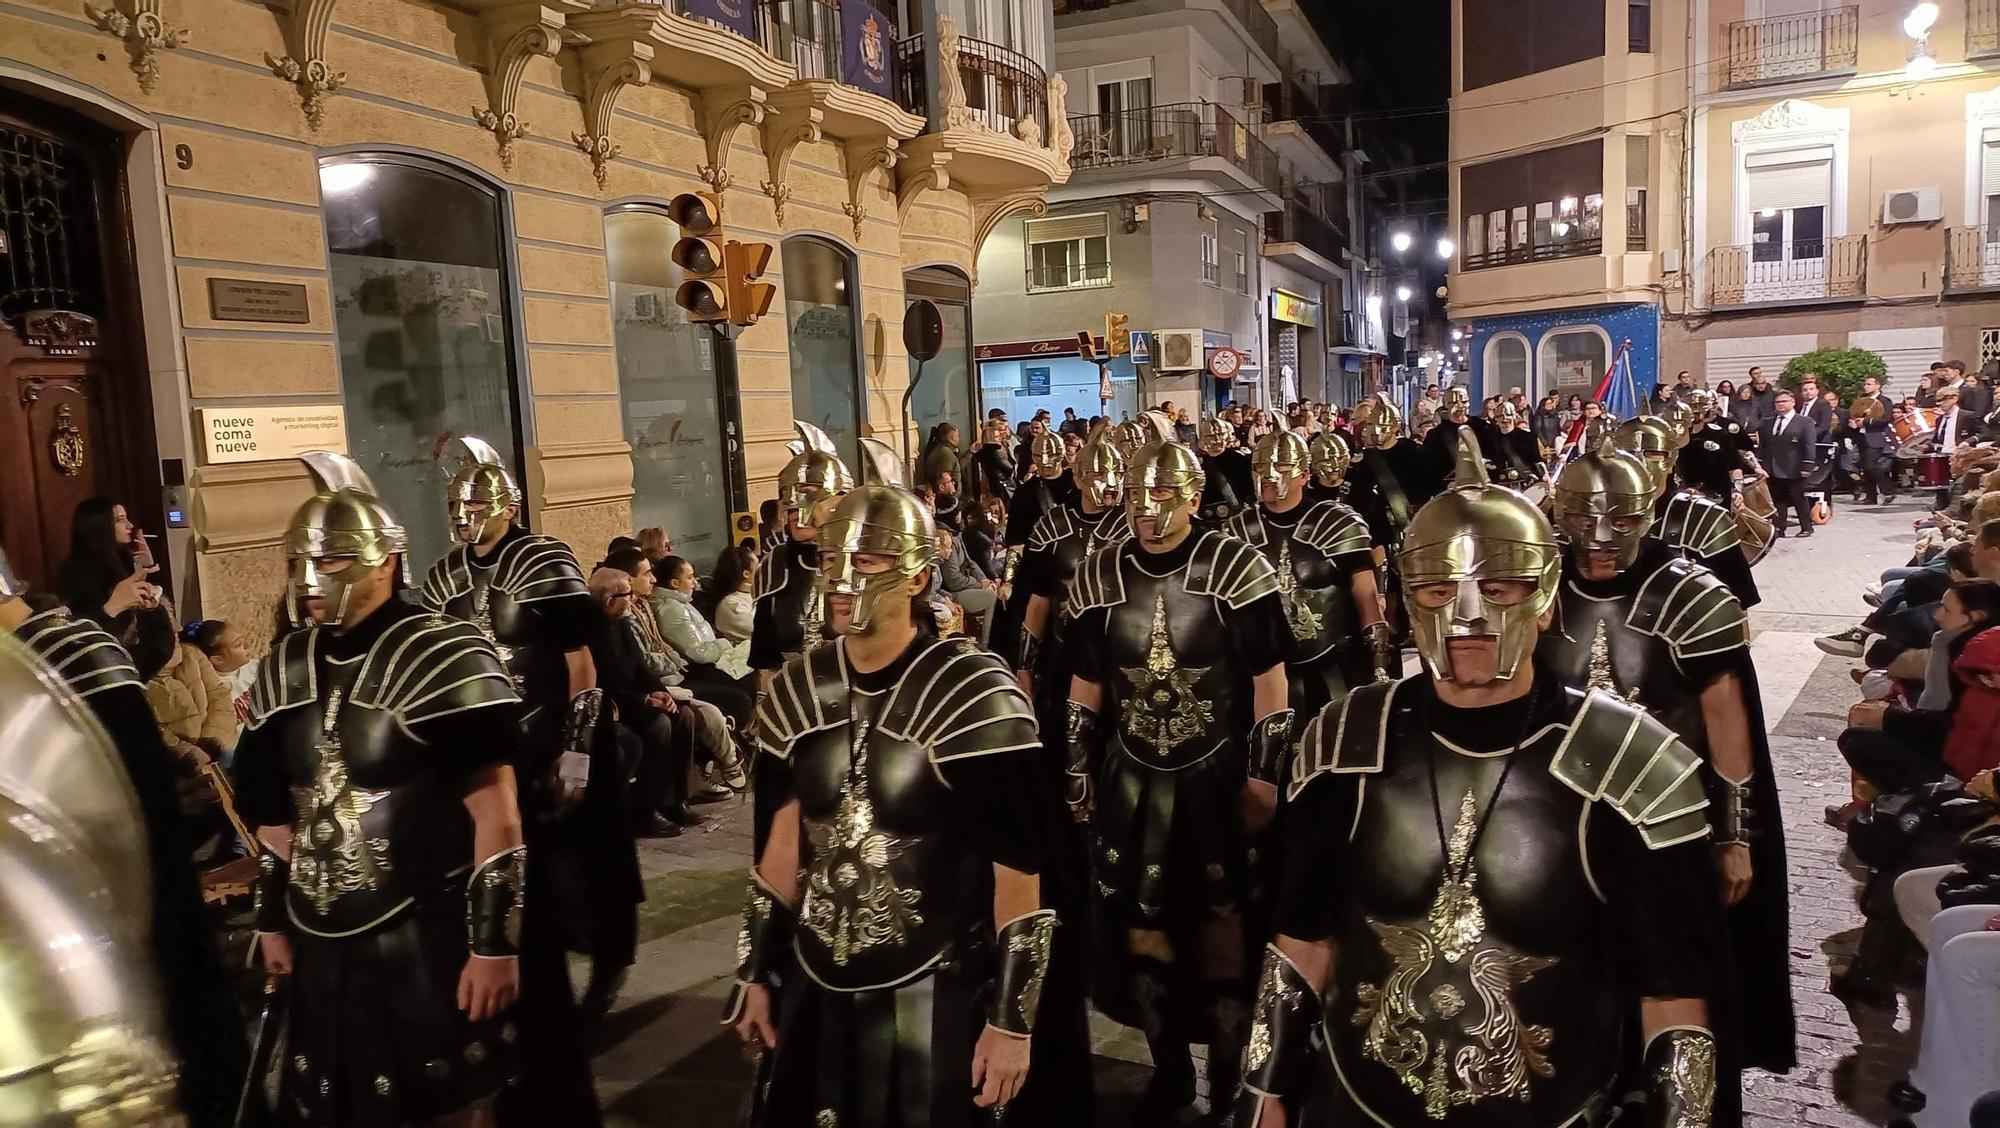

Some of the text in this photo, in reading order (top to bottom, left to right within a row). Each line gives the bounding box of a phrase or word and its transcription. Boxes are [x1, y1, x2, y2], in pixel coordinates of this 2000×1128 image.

[175, 143, 194, 170] 9
[1031, 342, 1061, 353] Bar
[213, 417, 254, 428] nueve
[320, 421, 338, 429] digital
[214, 429, 252, 440] coma
[215, 442, 257, 453] nueve
